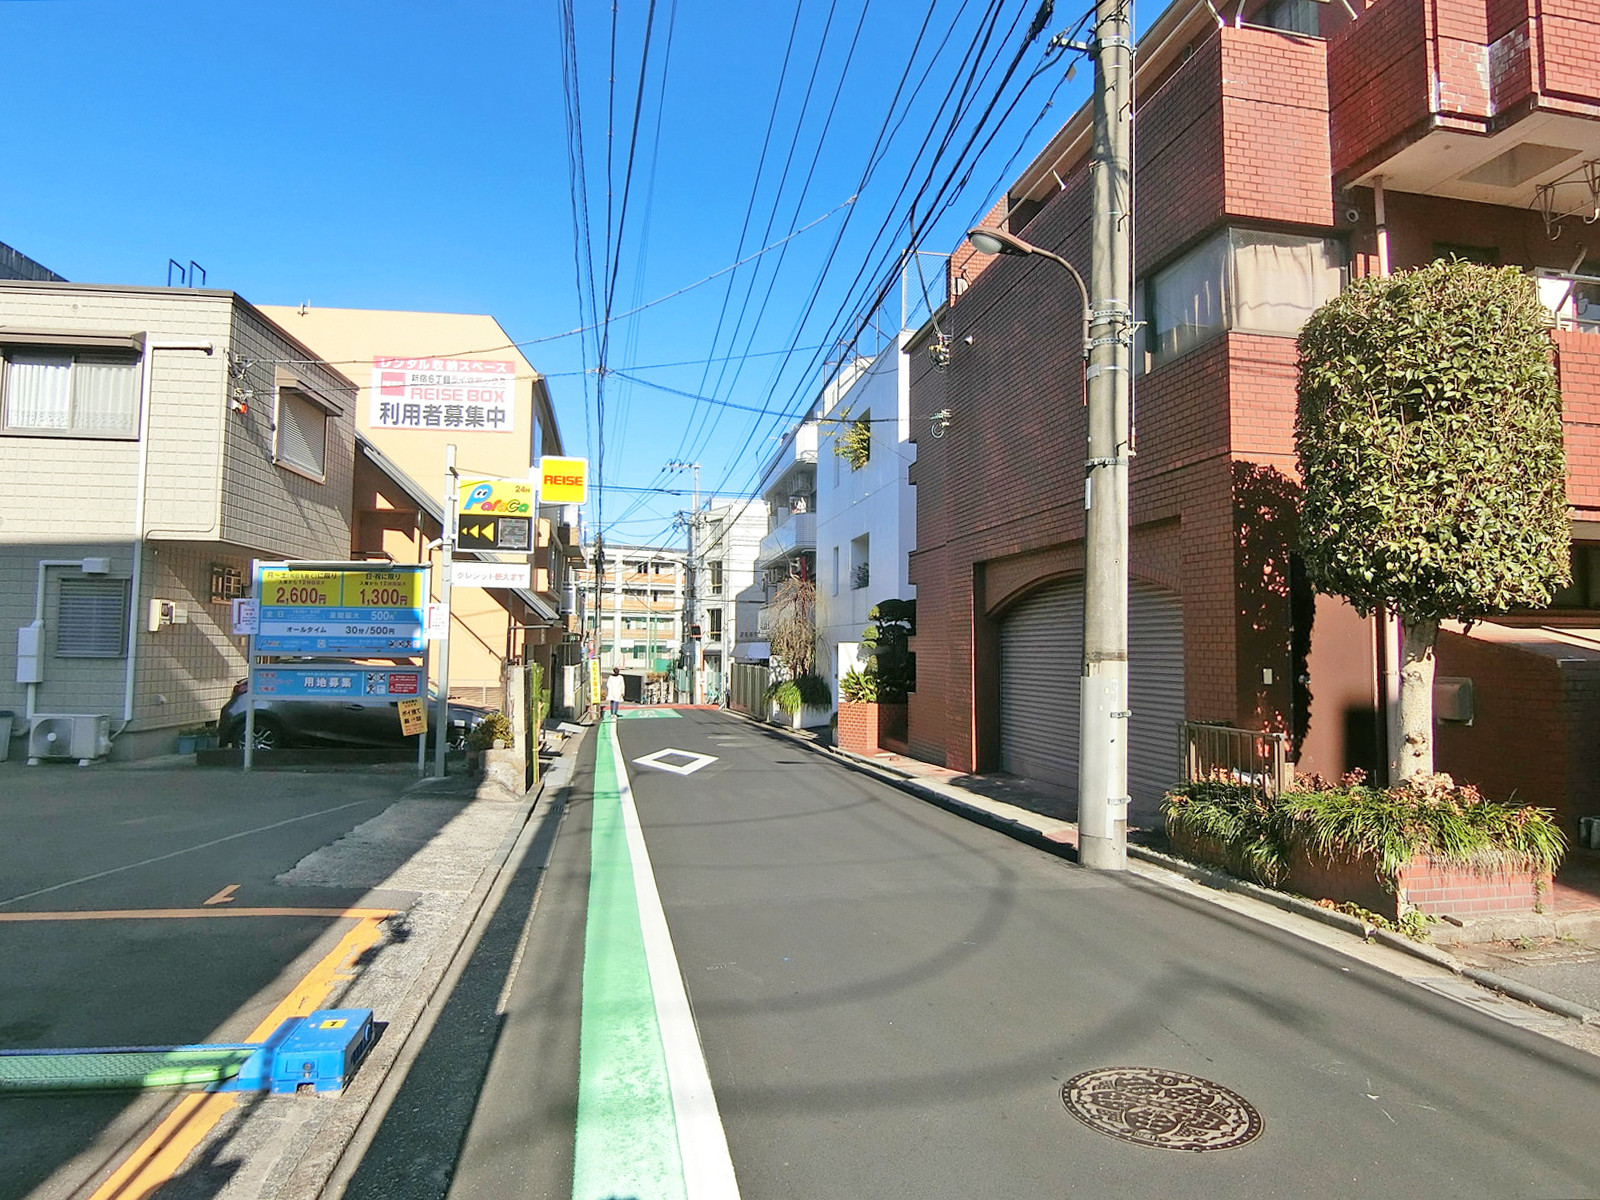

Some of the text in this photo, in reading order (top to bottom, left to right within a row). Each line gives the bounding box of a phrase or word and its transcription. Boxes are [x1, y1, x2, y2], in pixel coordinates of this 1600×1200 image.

[380, 359, 507, 373] レンタル収納スペース
[411, 387, 505, 403] REISE BOX
[380, 402, 506, 428] 利用者募集中
[544, 475, 583, 486] REISE
[276, 587, 326, 604] 2,600円
[360, 588, 407, 605] 1,300円
[286, 626, 327, 634] オールタイム
[304, 676, 352, 688] 用地募集
